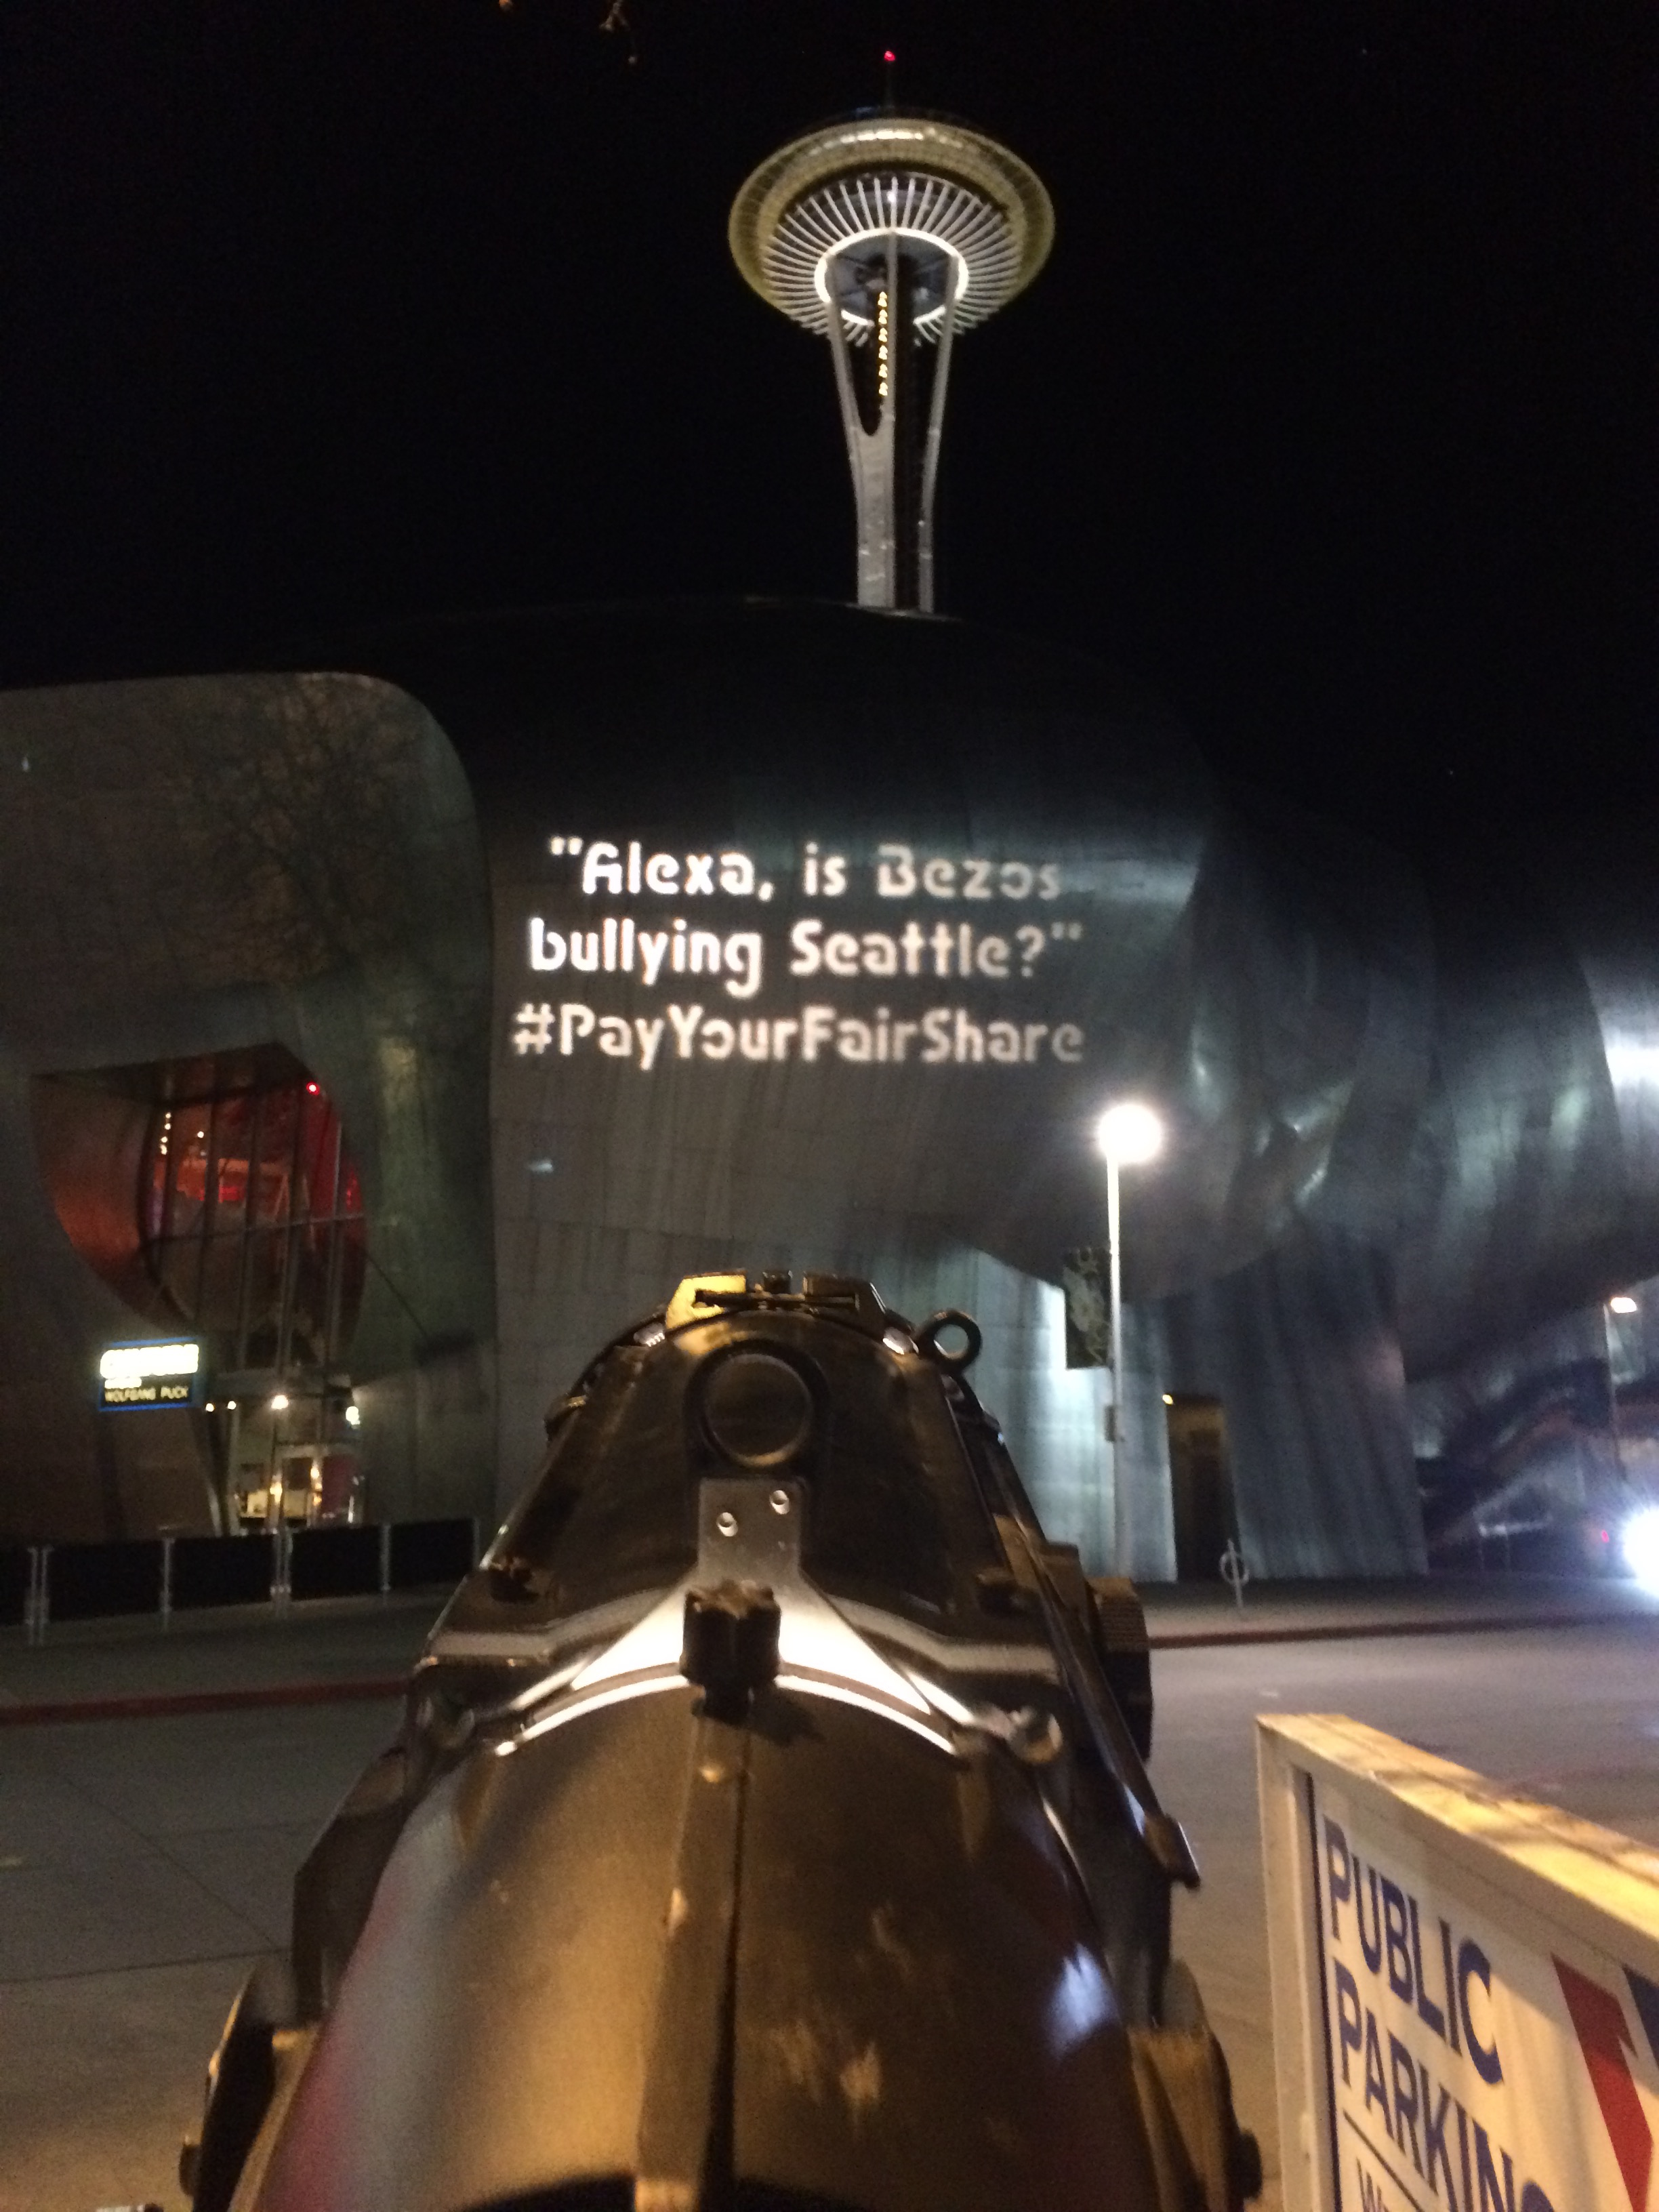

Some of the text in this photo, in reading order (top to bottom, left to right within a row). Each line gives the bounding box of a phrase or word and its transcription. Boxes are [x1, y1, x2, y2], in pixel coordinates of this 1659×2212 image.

[550, 836, 1060, 902] "Alexa, is Bezos
[529, 917, 1082, 1000] bullying Seattle?"
[513, 1004, 1083, 1071] #PayYourFairShare
[1323, 1815, 1504, 2085] PUBLIC
